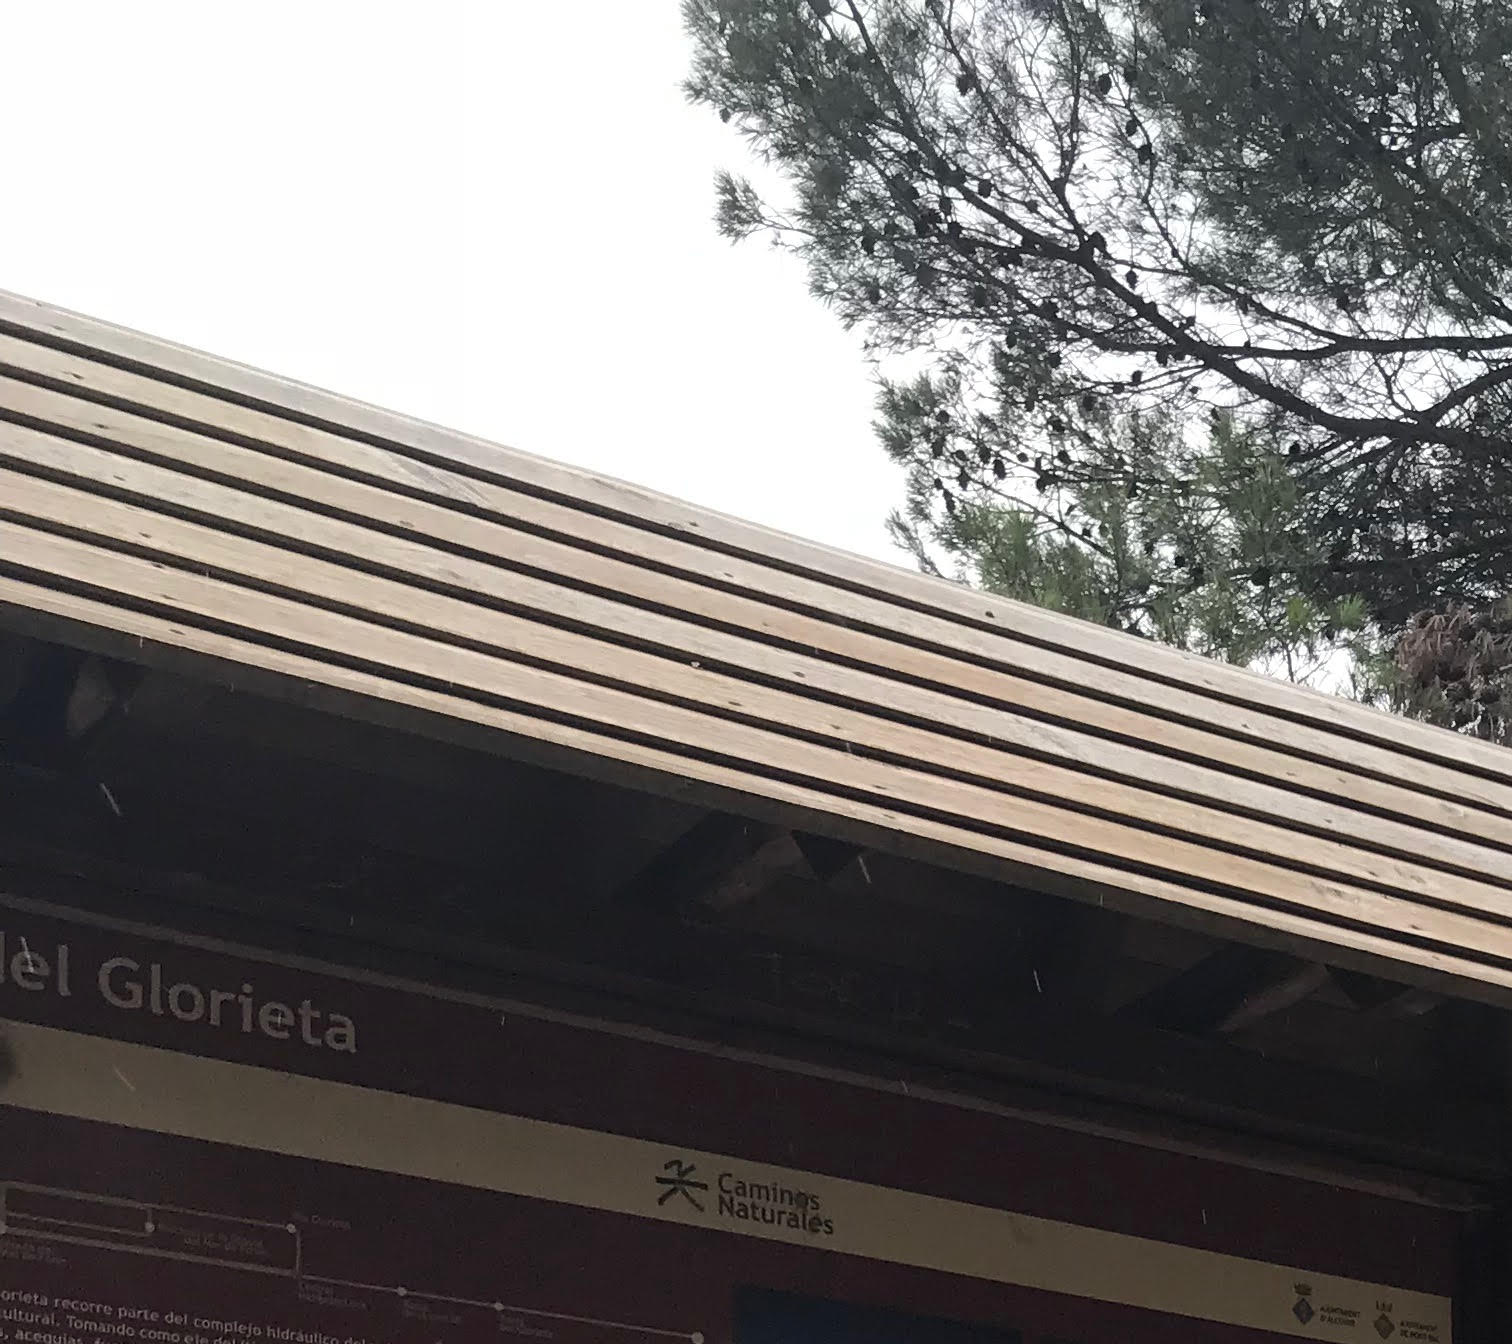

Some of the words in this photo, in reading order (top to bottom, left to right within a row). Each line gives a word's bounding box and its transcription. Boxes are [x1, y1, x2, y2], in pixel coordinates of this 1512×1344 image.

[0, 931, 71, 996] el
[98, 957, 357, 1054] Glorieta
[718, 1173, 820, 1210] Caminos
[718, 1194, 834, 1234] Naturales
[54, 1298, 112, 1315] recorre
[118, 1307, 158, 1321] parte
[165, 1310, 186, 1325] del
[194, 1317, 260, 1338] complejo
[66, 1315, 134, 1336] Tomando
[140, 1328, 179, 1342] como
